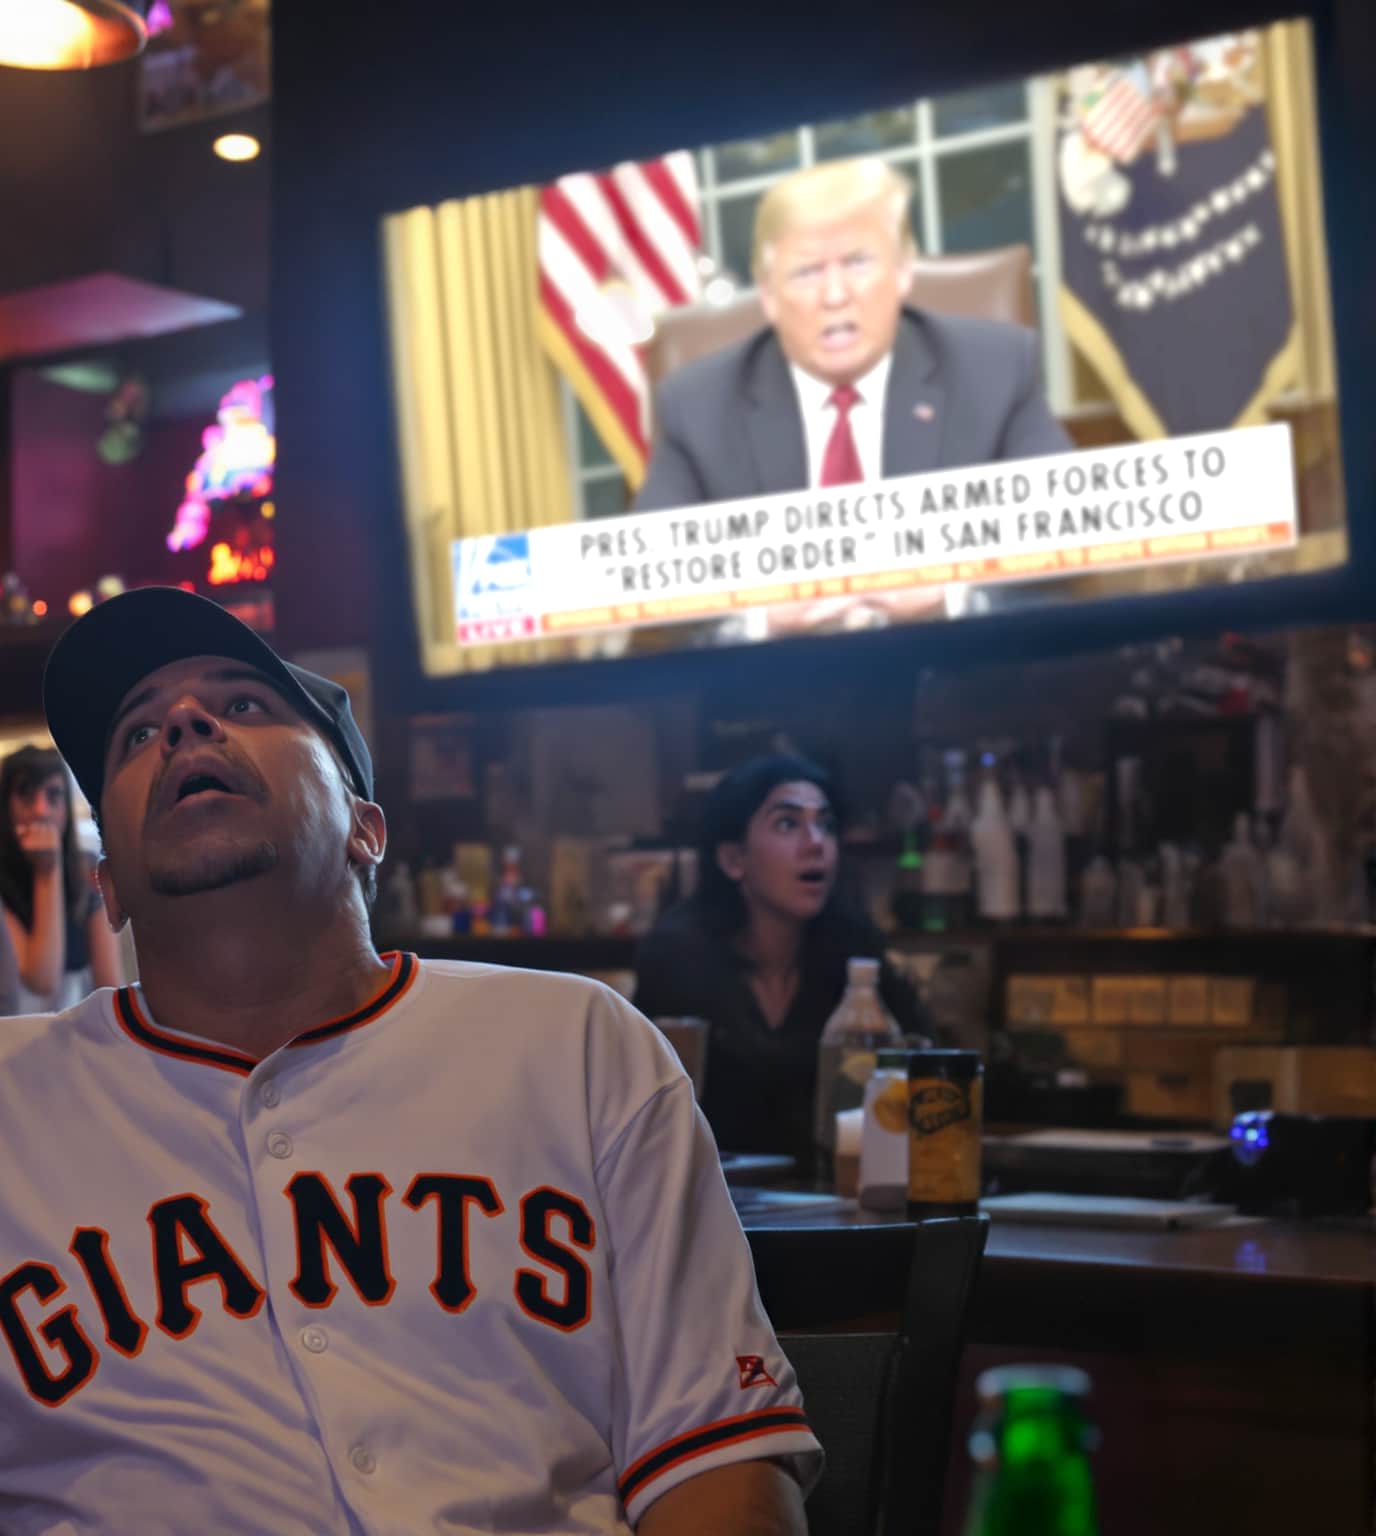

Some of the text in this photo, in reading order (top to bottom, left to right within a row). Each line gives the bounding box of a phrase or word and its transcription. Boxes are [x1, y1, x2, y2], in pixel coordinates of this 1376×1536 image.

[580, 446, 1225, 560] PRES. TRUMP DIRECTS ARMED FORCES TO
[894, 529, 923, 557] IN
[941, 518, 1001, 552] SAN
[1018, 490, 1202, 541] FRANCISCO
[463, 617, 524, 639] LIVE
